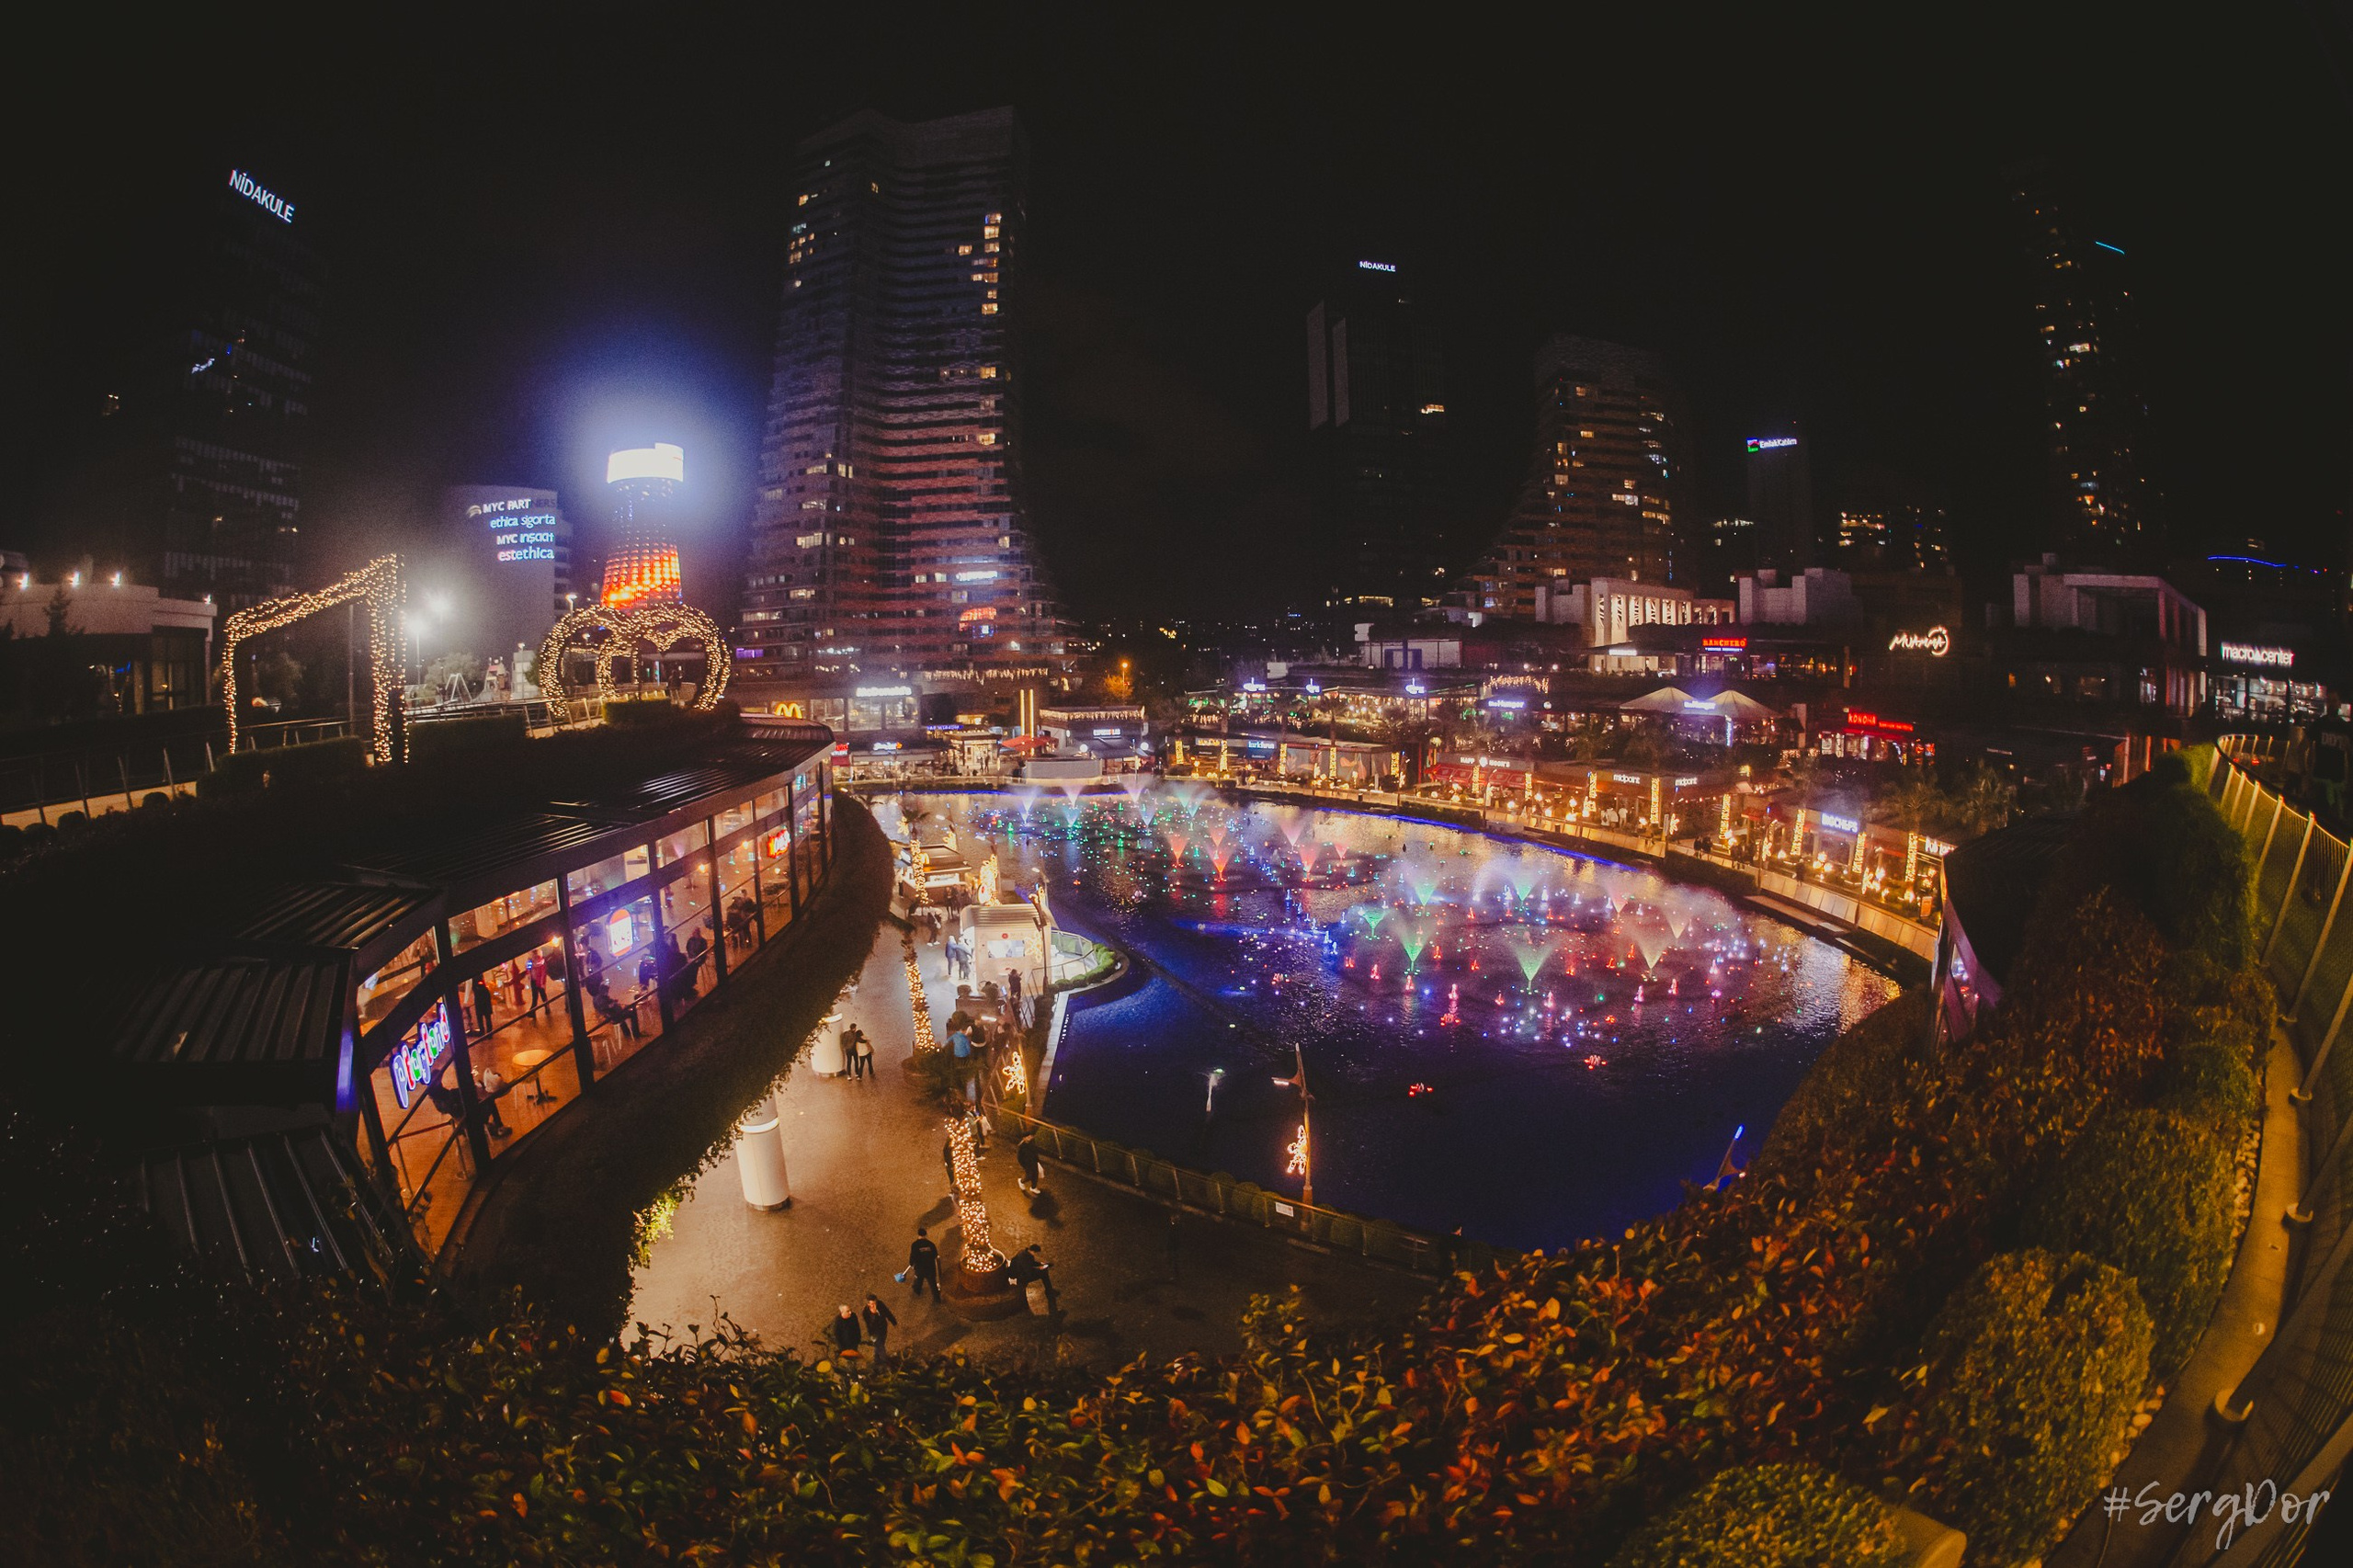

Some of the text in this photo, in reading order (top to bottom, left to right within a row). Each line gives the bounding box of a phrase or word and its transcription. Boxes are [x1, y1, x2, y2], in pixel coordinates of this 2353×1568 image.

[230, 169, 295, 223] NİDAKULE
[483, 502, 506, 514] MYC
[490, 514, 556, 528] ethica sigorta
[496, 534, 518, 545] MYC
[497, 546, 555, 562] estethica
[392, 1003, 450, 1108] playland
